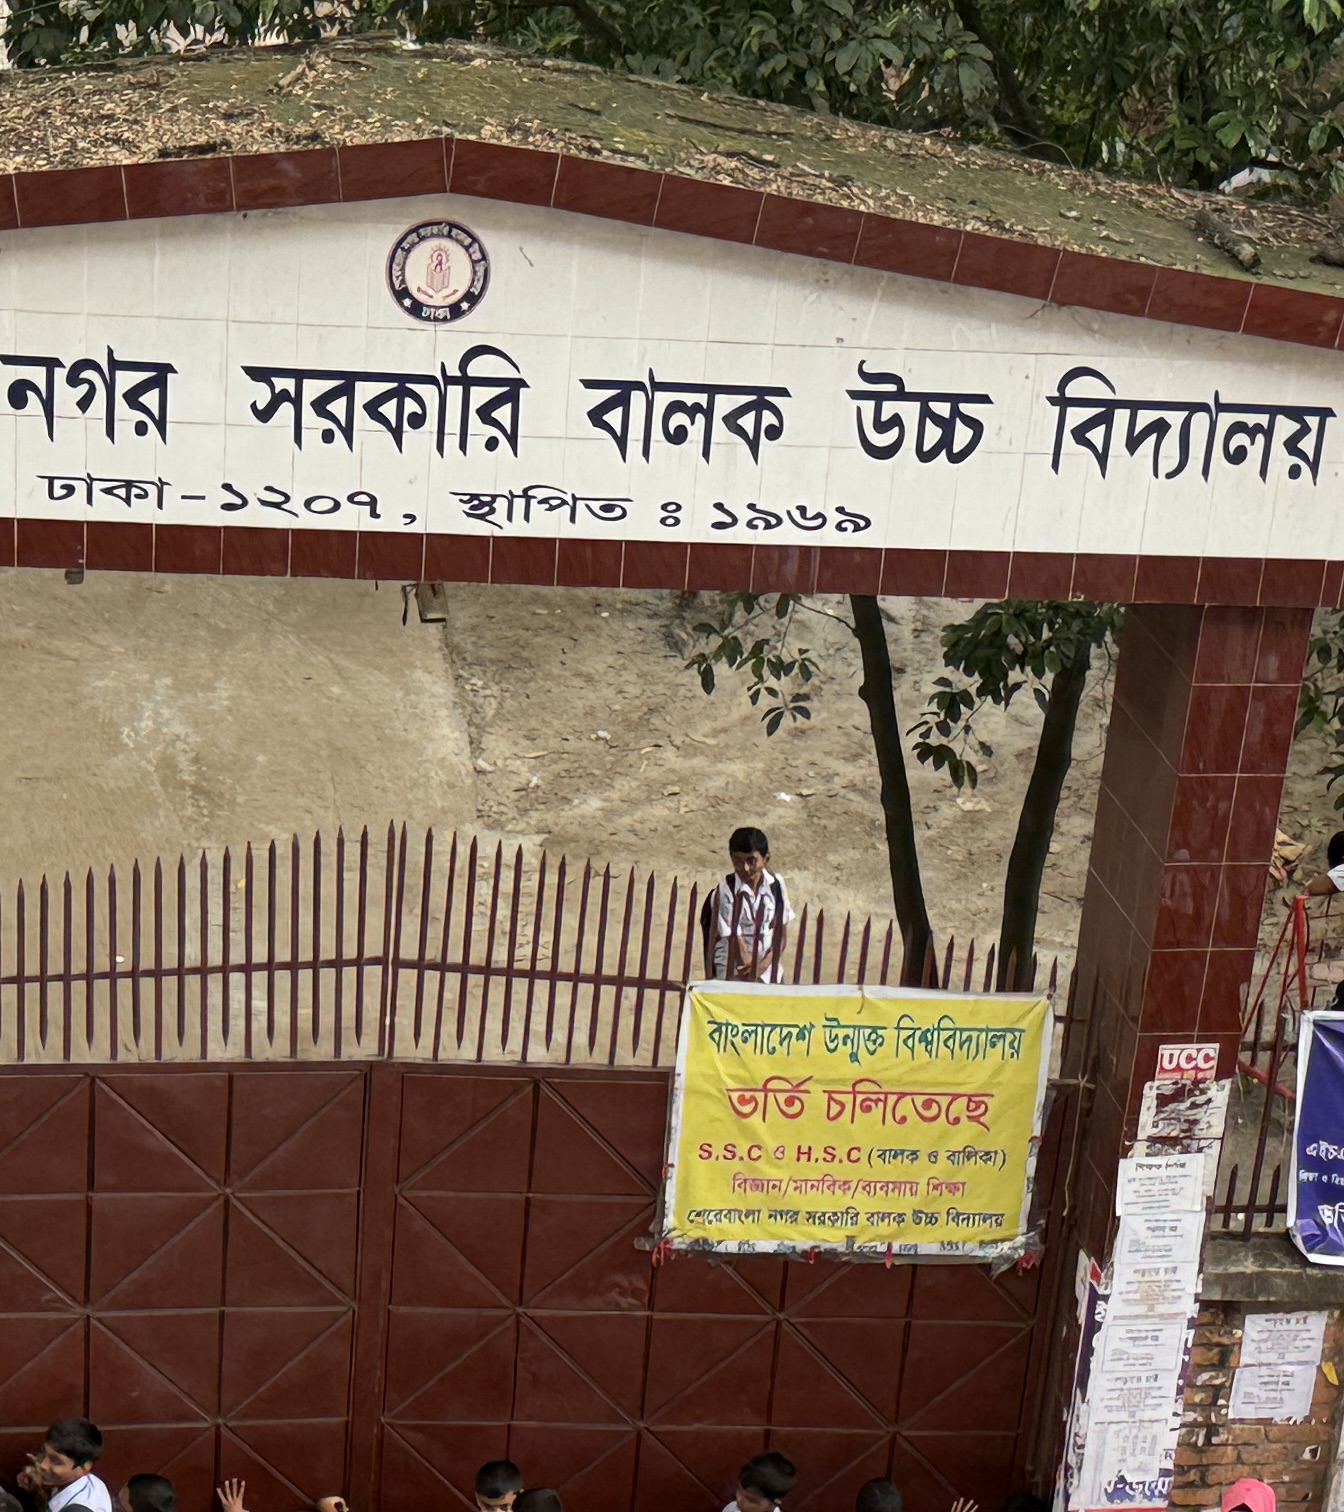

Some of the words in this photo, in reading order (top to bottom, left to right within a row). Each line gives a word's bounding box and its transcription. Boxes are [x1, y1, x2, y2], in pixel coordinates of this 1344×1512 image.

[242, 344, 530, 461] সরকারি
[580, 368, 792, 466] বালক
[846, 359, 992, 465] উচ্চ
[1047, 366, 1336, 486] বিদ্যালয়
[450, 487, 633, 530] স্থাপিত
[709, 499, 873, 535] ১৯৬৯
[707, 1020, 815, 1058] বাংলাদেশ
[823, 1014, 887, 1067] উন্মুক্ত
[894, 1015, 1026, 1061] বিশ্ববিদ্যালয়
[1161, 1049, 1215, 1070] UCC
[726, 1075, 813, 1124] ভর্তি
[822, 1079, 994, 1131] চলিতেছে
[698, 1142, 763, 1161] S.S.C
[796, 1145, 862, 1165] H.S.C
